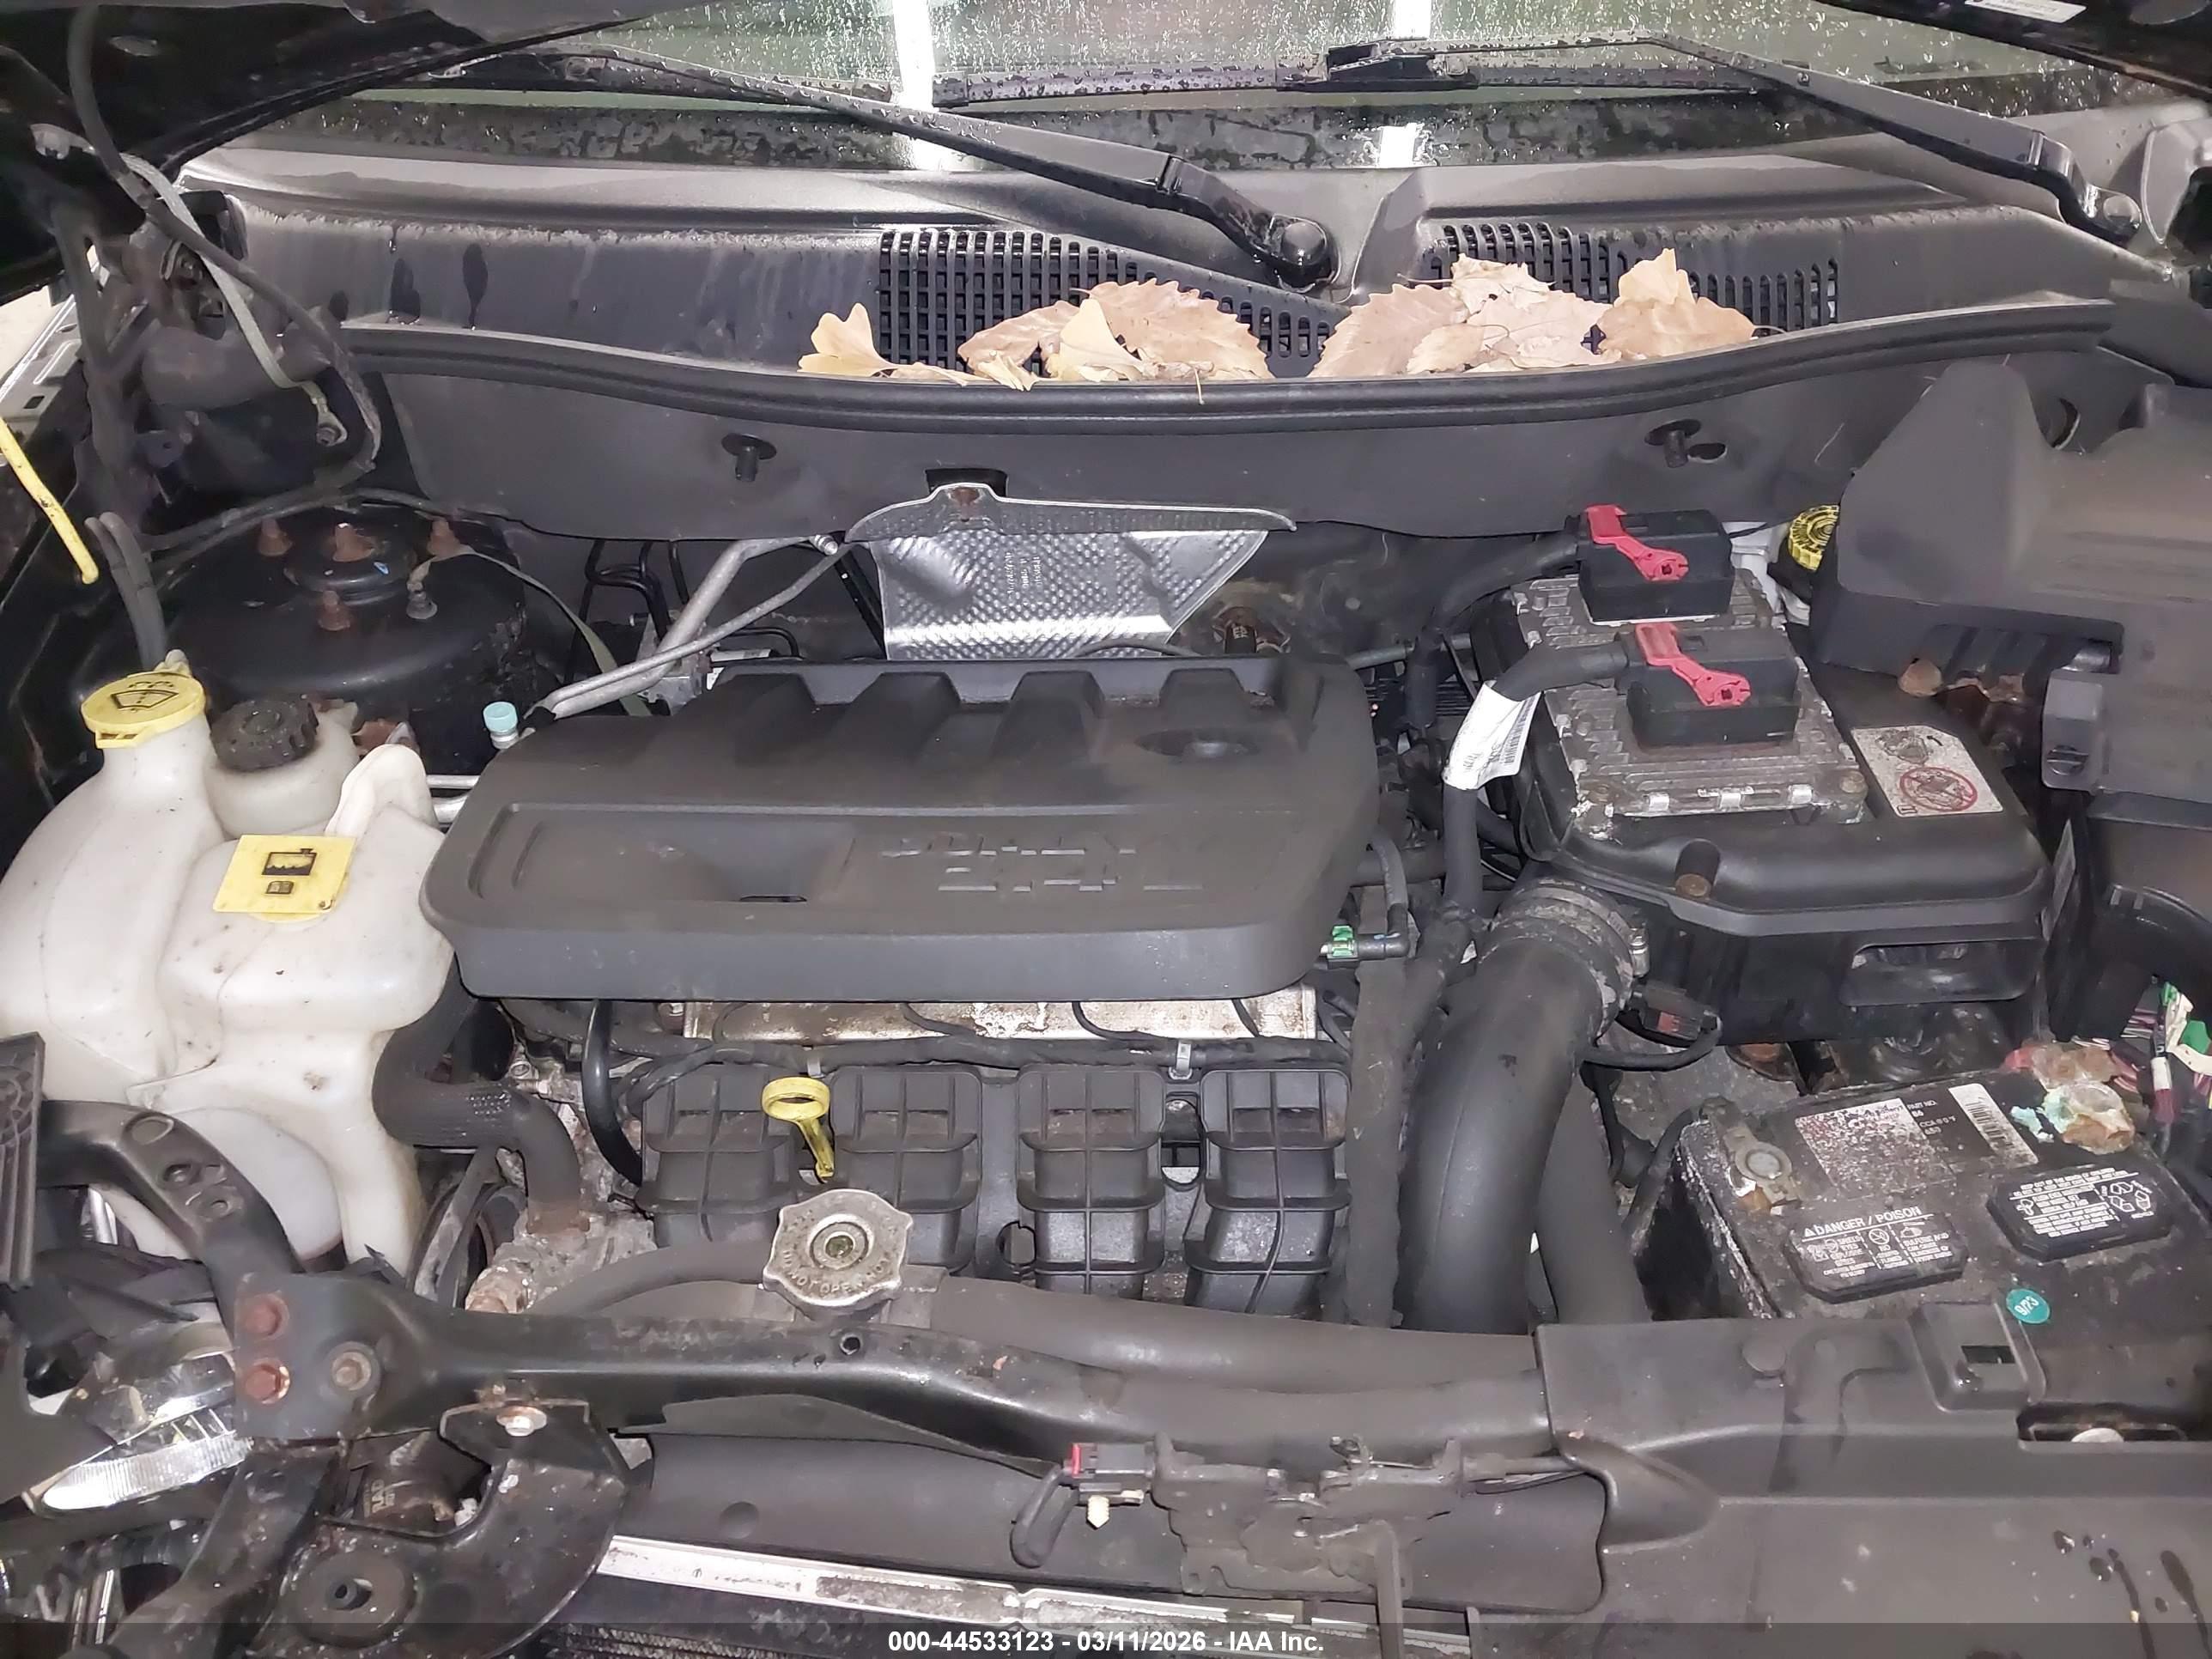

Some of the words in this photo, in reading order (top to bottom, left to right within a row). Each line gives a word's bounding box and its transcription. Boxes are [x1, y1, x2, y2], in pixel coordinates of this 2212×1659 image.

[1814, 1217, 1865, 1236] DANGER
[1875, 1206, 1923, 1224] POISON
[2014, 1295, 2039, 1316] 9/23
